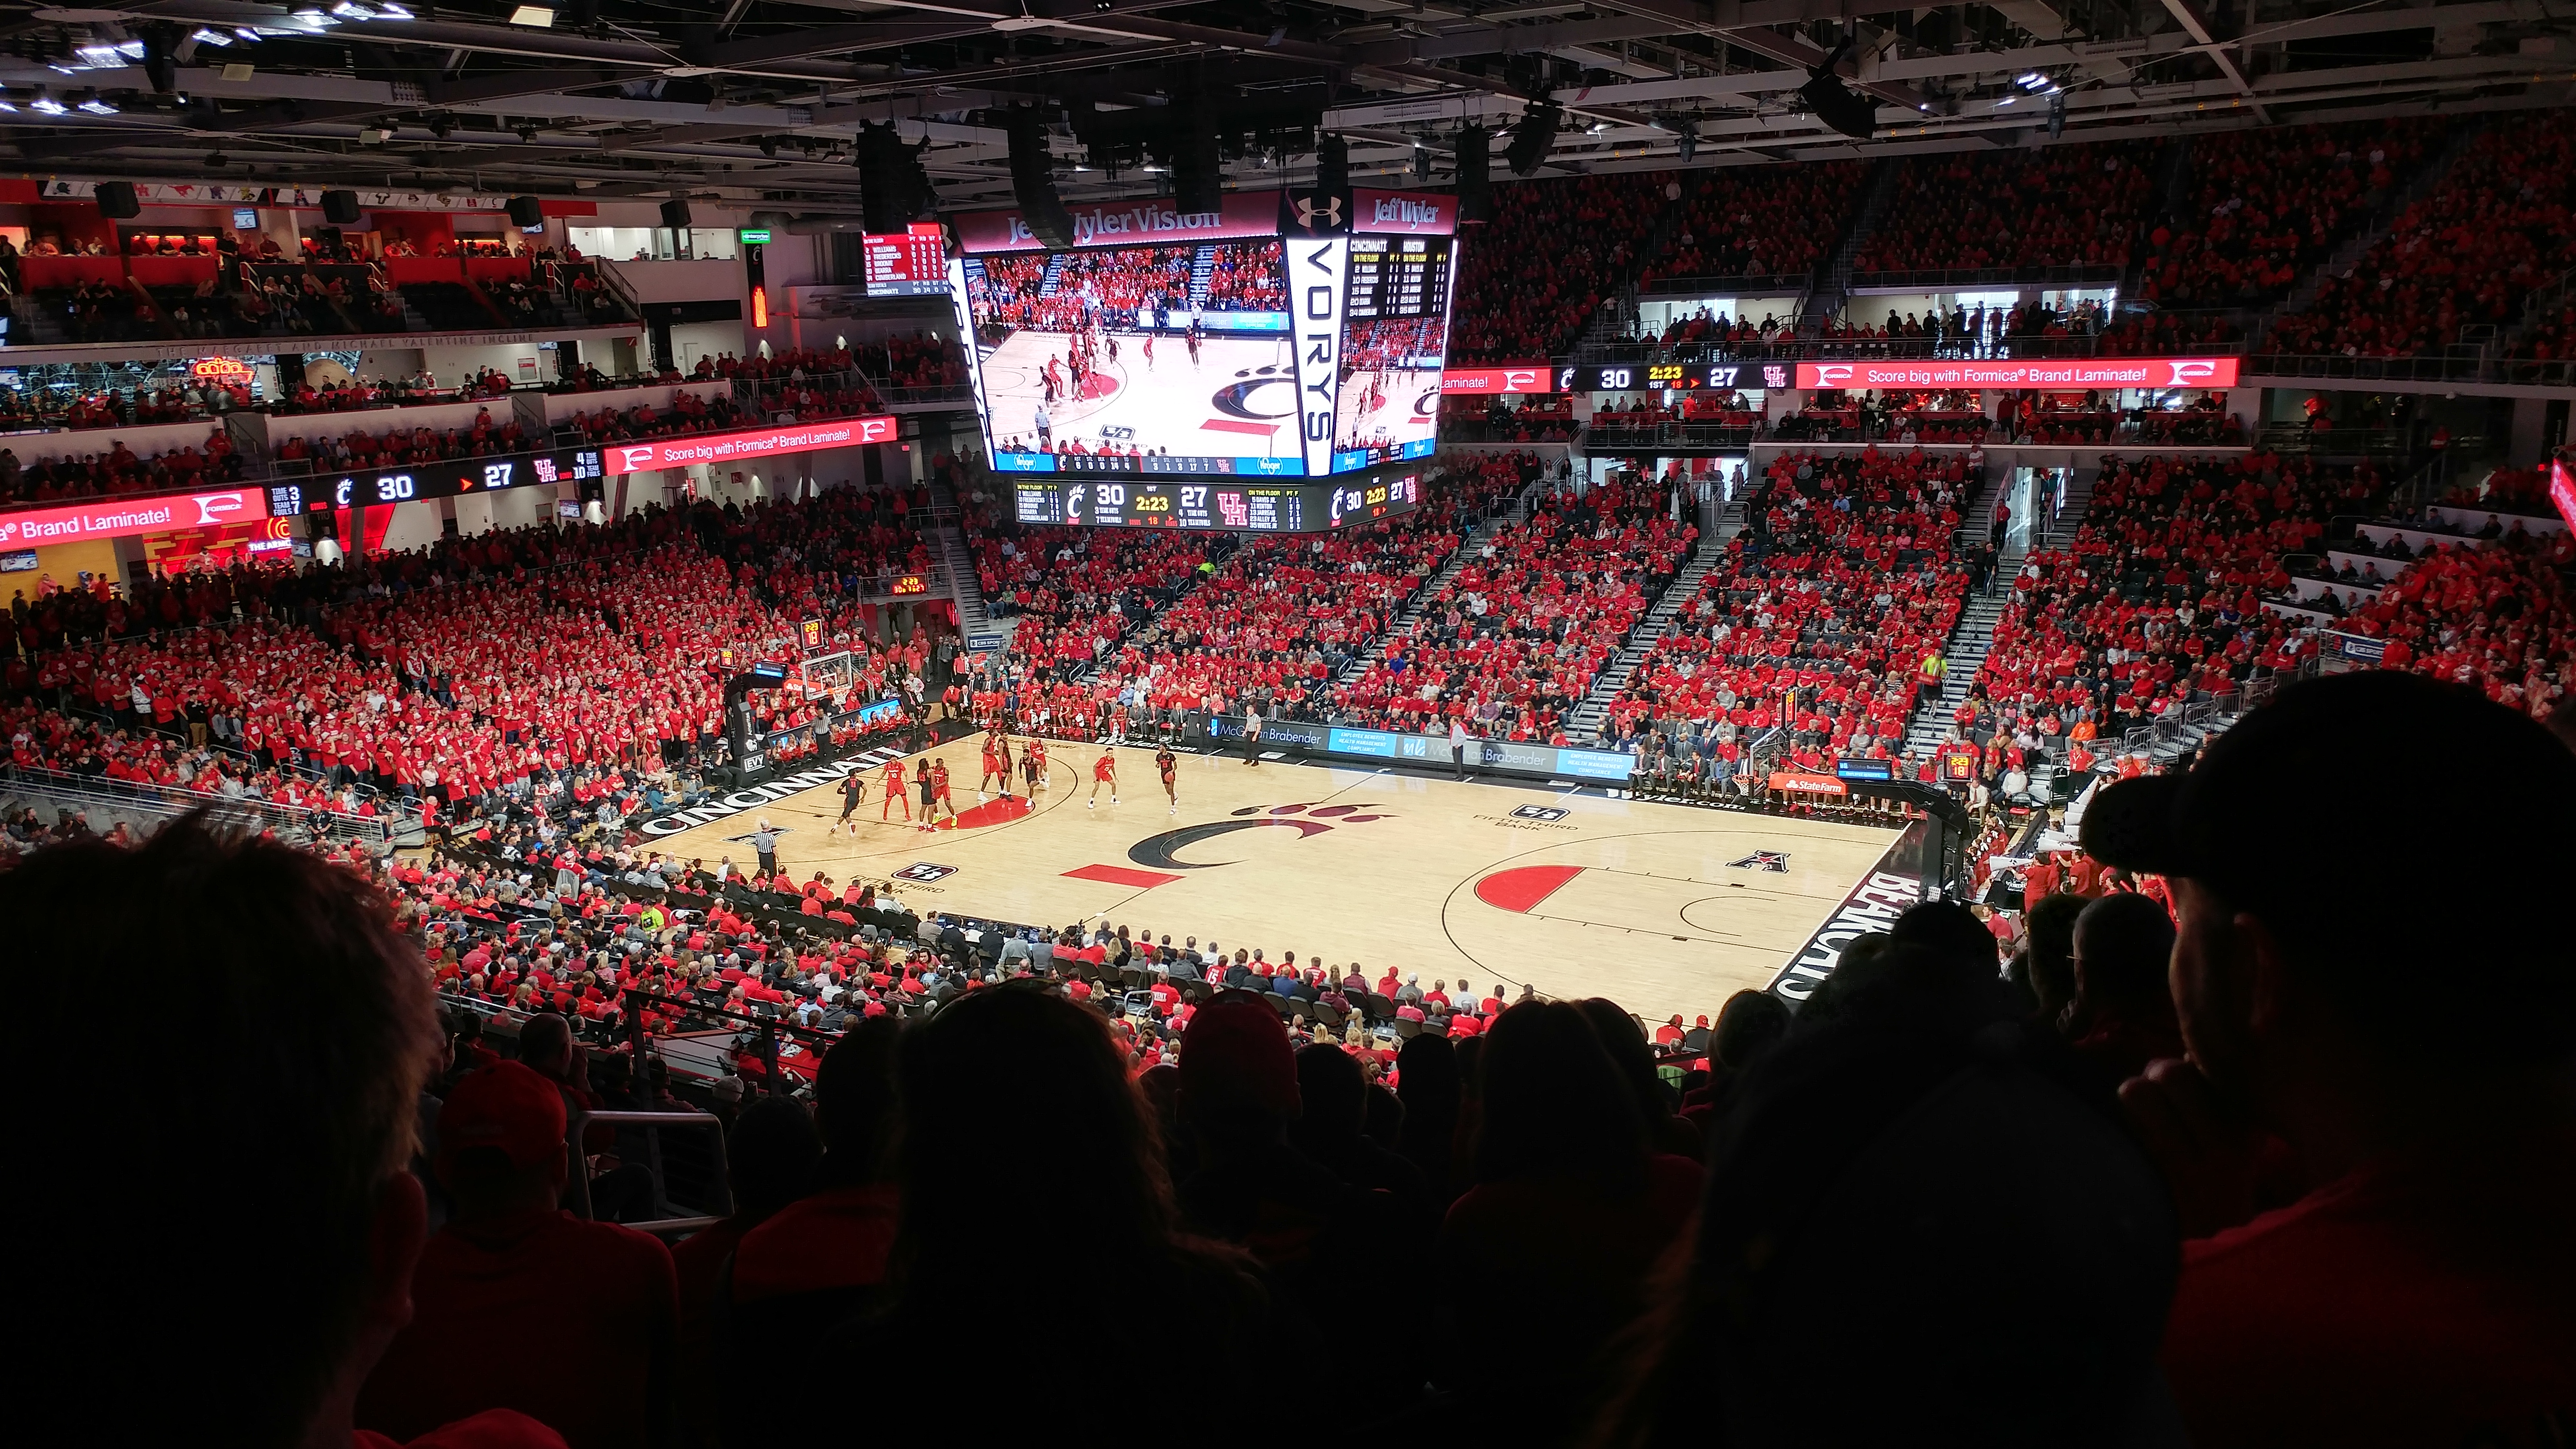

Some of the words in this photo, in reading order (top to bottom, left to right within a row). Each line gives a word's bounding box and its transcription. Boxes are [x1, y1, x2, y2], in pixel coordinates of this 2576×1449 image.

[1371, 197, 1401, 225] Jeff
[1401, 200, 1439, 229] Wyler
[1350, 239, 1387, 252] CINCINNATI
[1403, 240, 1425, 252] HOUSTON
[292, 342, 322, 351] AND
[332, 339, 395, 350] MICHAEL
[403, 337, 475, 347] VALENTINE
[1307, 242, 1332, 441] VORYS
[1601, 370, 1629, 388] 30
[1649, 367, 1682, 380] 2:23
[1710, 368, 1738, 386] 27
[1868, 370, 1906, 383] Score
[1909, 370, 1930, 386] big
[1933, 369, 1960, 382] with
[2029, 369, 2071, 382] Brand
[2075, 368, 2146, 382] Laminate!
[1441, 376, 1488, 388] aminate!
[664, 447, 695, 462] Score
[697, 444, 713, 459] big
[715, 442, 734, 455] with
[780, 432, 807, 448] Brand
[808, 429, 851, 444] Laminate!
[576, 452, 585, 465] 4
[1016, 455, 1034, 470] Kroger
[573, 466, 586, 479] 10
[1260, 458, 1280, 475] Kroger
[484, 464, 512, 487] 27
[289, 486, 300, 500] 3
[377, 476, 414, 500] 30
[1096, 485, 1125, 505] 30
[1391, 482, 1403, 500] 27
[1181, 486, 1207, 507] 27
[1346, 491, 1362, 511] 30
[1366, 487, 1386, 505] 2:23
[206, 503, 242, 513] FORMICA
[291, 501, 300, 515] 7
[1136, 496, 1169, 511] 2:23
[1178, 509, 1183, 517] 4
[21, 517, 80, 538] Brand
[83, 507, 171, 531] Laminate!
[1148, 516, 1158, 525] 18
[1179, 519, 1187, 527] 10
[248, 543, 267, 551] THE
[805, 623, 819, 632] 2:23
[808, 631, 819, 645] 18
[1269, 727, 1322, 745] Brabender
[1340, 731, 1363, 740] EMPLOYEE
[1356, 740, 1387, 748] MANAGEMENT
[745, 756, 764, 770] LEVY
[1485, 748, 1546, 766] Brabender
[1570, 753, 1597, 761] EMPLOYEE
[1951, 757, 1969, 766] 2:23
[1588, 762, 1624, 770] MANAGEMENT
[1953, 766, 1965, 777] 18
[642, 746, 911, 835] CINCINNATI
[1798, 781, 1841, 793] StateFarm
[1473, 815, 1520, 823] FIFTH
[1525, 821, 1578, 830] THIRD
[1495, 822, 1544, 831] BANK
[850, 874, 895, 884] FIFTH
[899, 882, 945, 893] THIRD
[1208, 971, 1219, 985] 15
